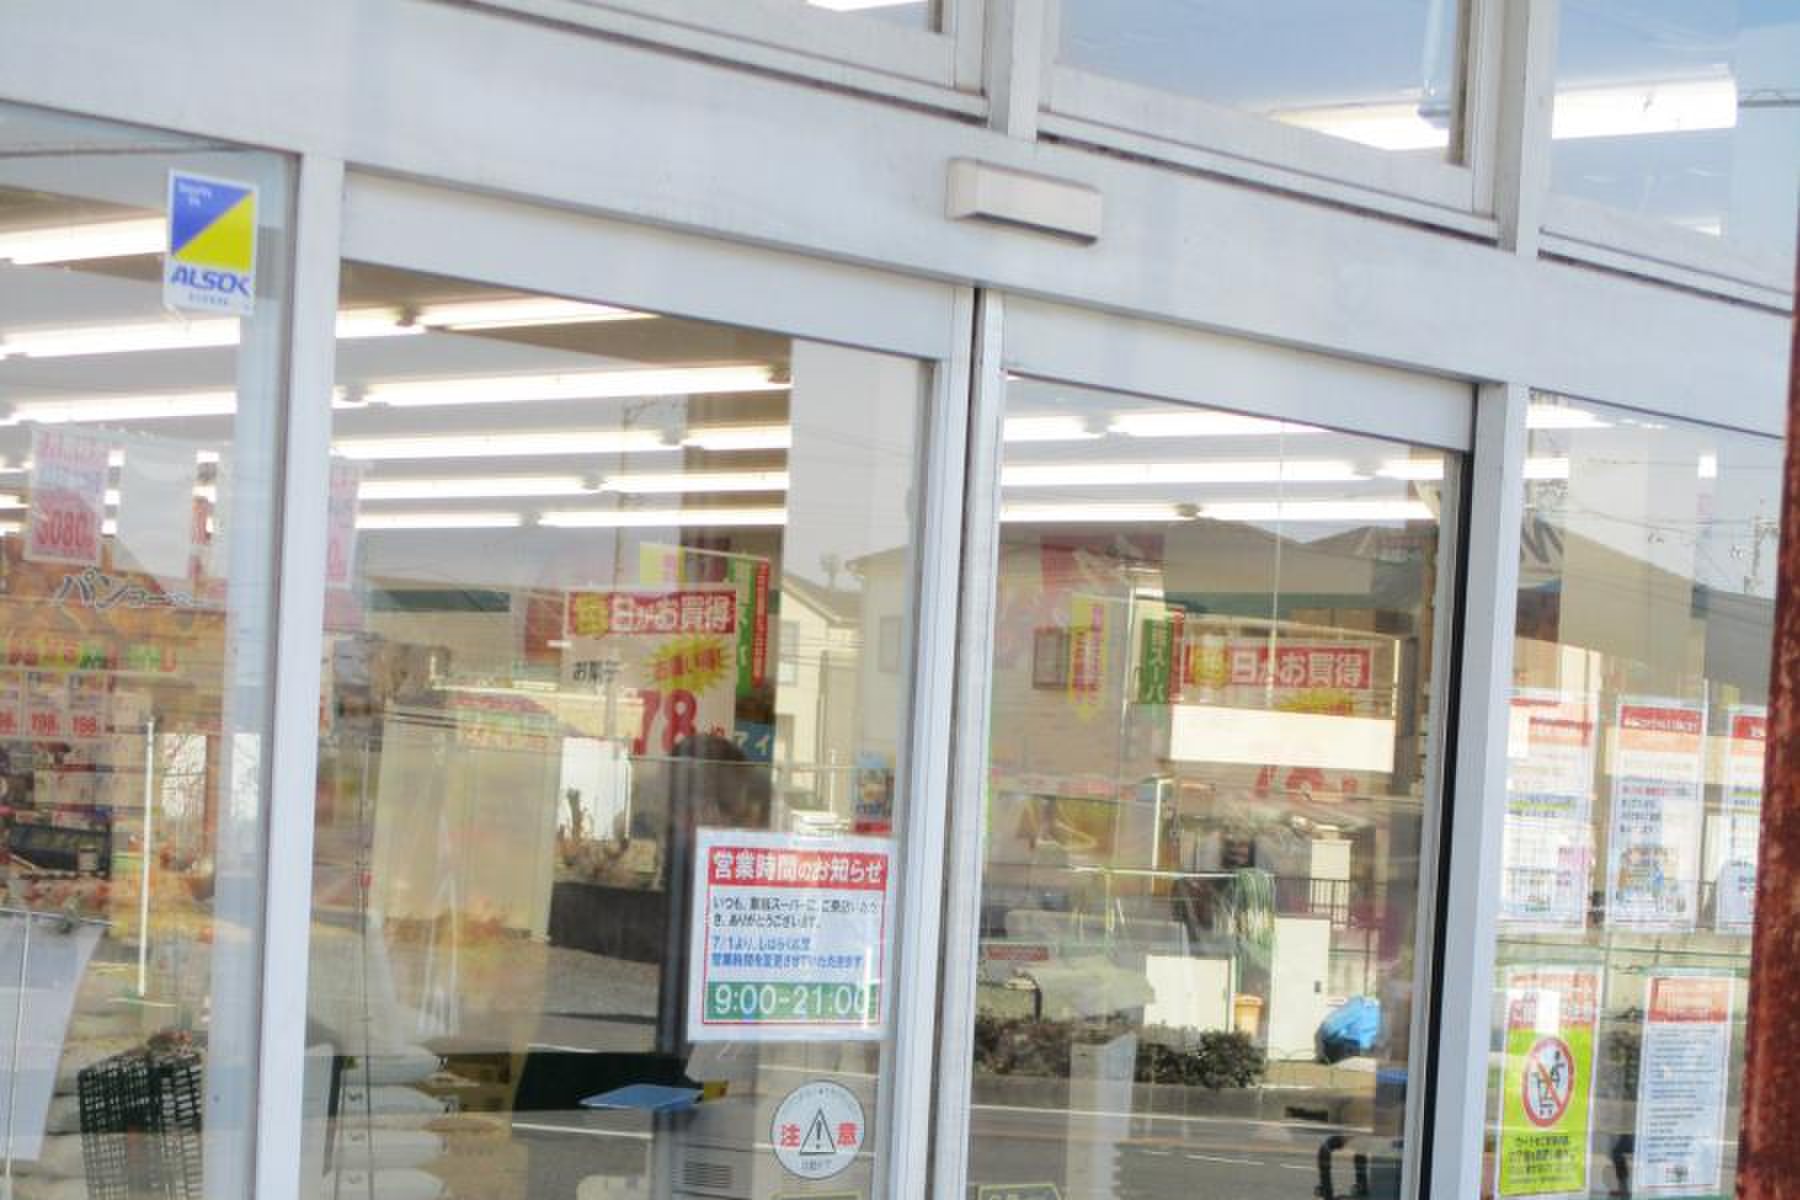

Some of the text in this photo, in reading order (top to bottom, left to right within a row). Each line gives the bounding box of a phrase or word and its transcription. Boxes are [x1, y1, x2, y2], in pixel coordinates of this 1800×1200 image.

[169, 265, 253, 297] ALSOK
[714, 851, 881, 881] 営業時間のお知らせ
